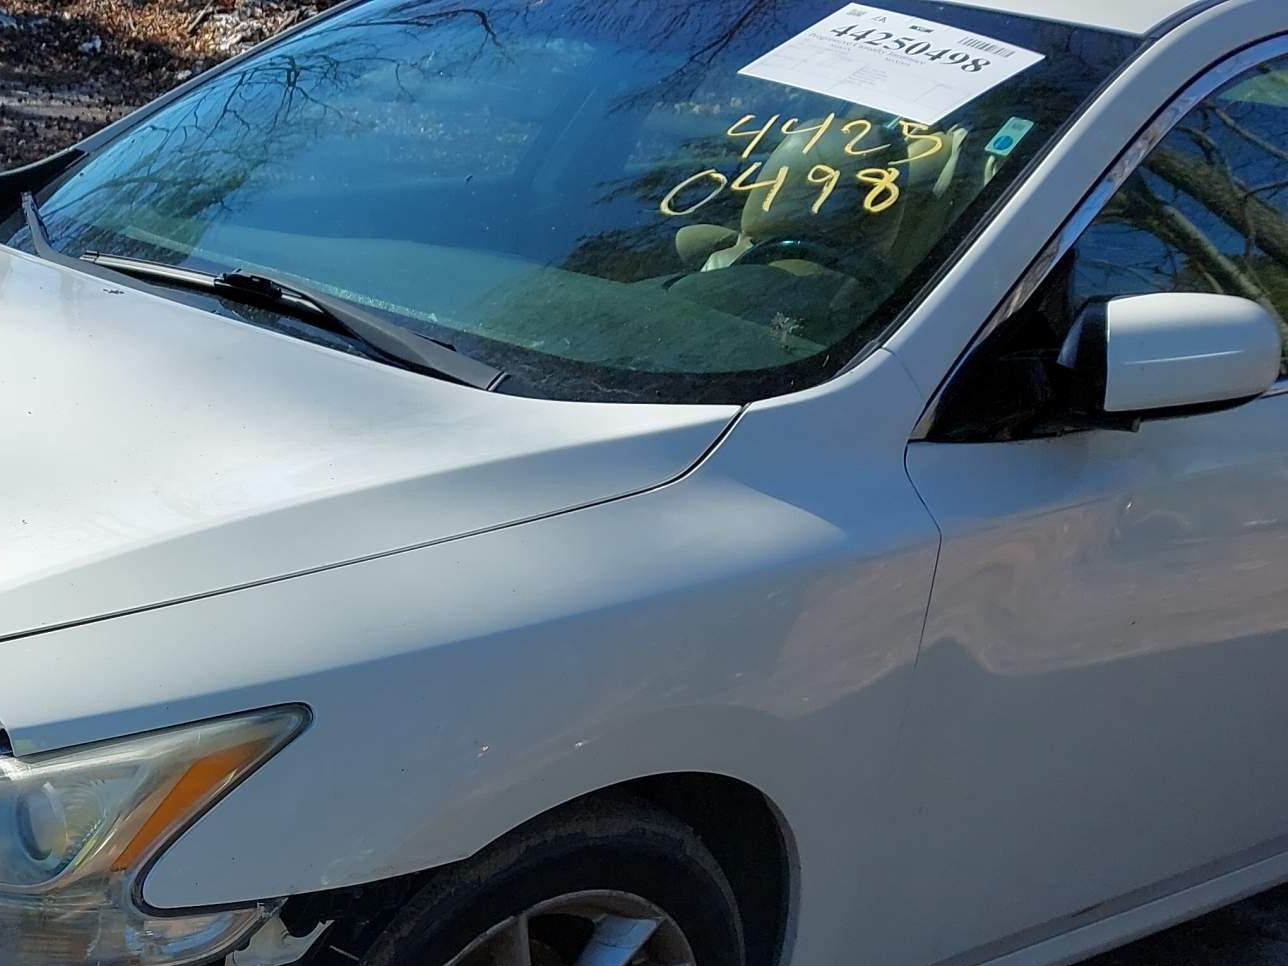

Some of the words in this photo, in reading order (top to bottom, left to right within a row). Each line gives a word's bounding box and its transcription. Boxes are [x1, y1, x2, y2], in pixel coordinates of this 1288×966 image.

[830, 24, 992, 73] 44250498
[726, 112, 944, 166] 4425
[660, 161, 900, 216] 0498
